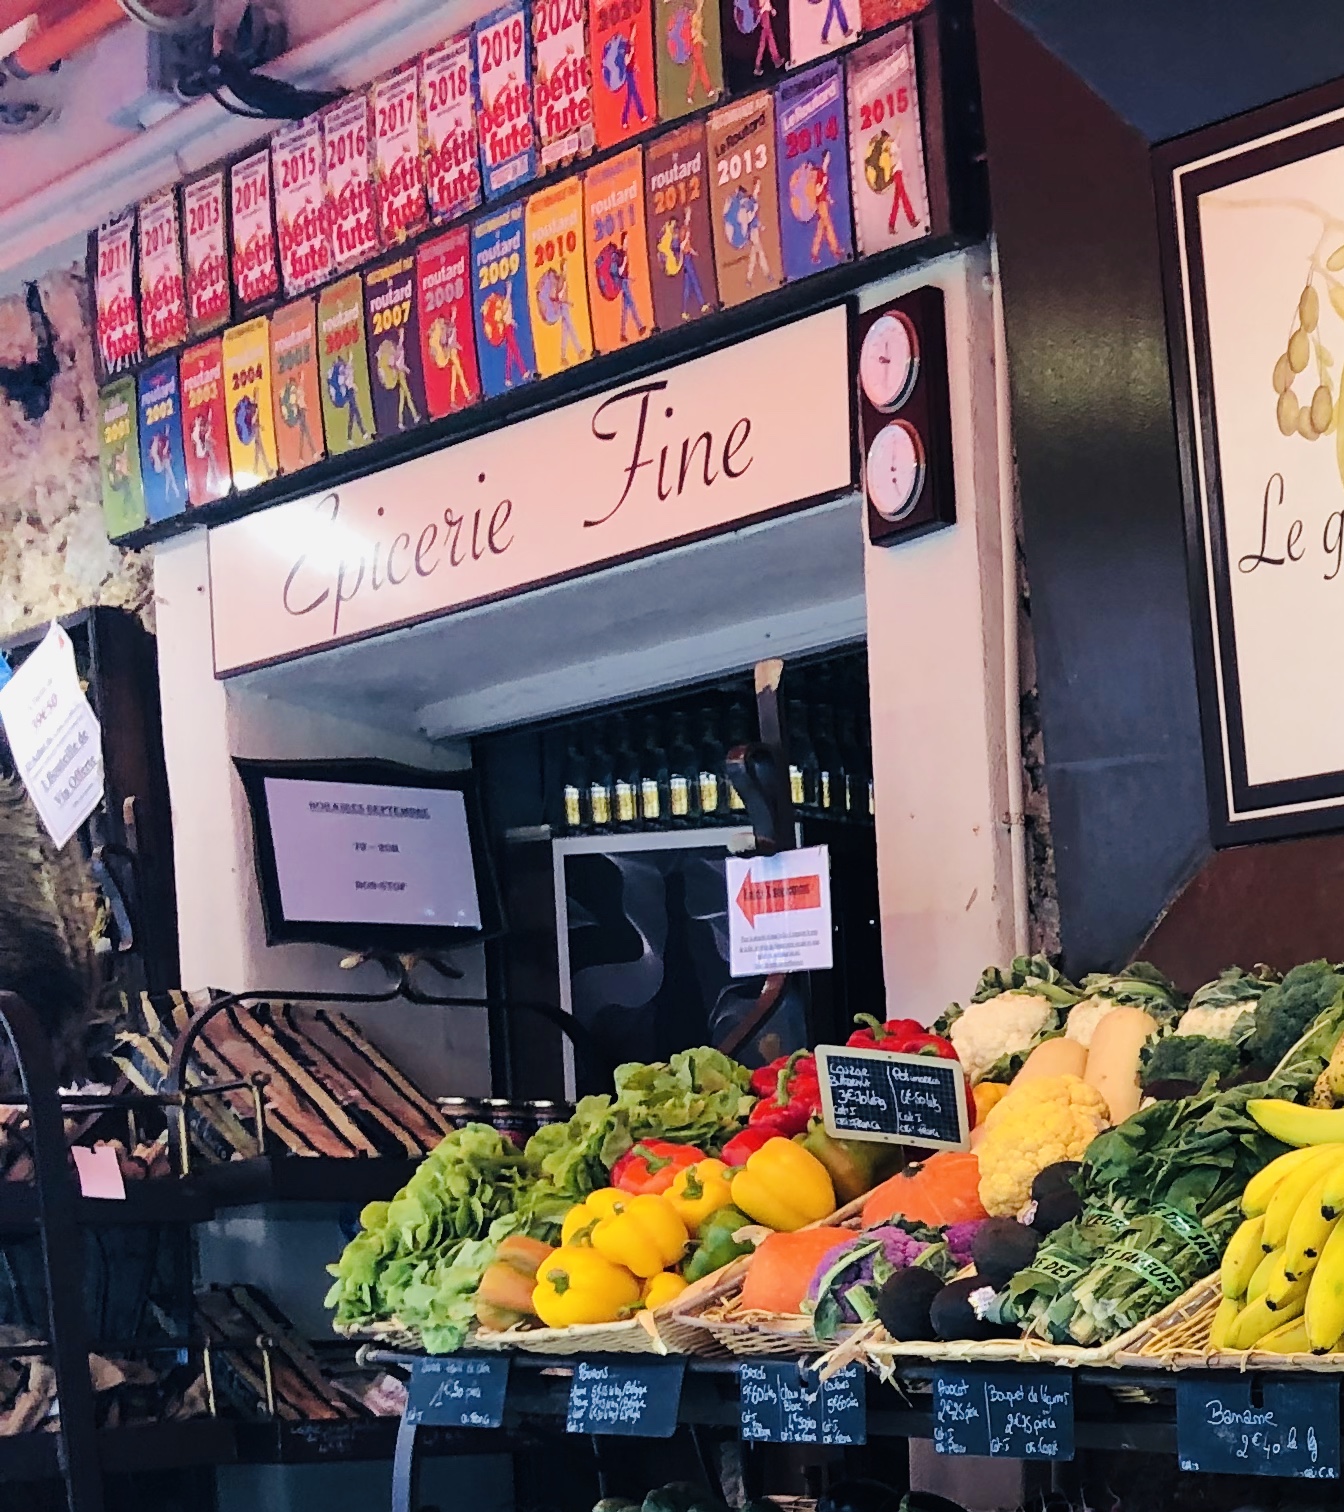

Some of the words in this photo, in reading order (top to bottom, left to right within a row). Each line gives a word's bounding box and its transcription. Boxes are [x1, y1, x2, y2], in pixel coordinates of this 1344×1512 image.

[481, 19, 522, 73] 2019
[429, 65, 466, 111] 2018
[378, 93, 414, 136] 2017
[860, 88, 908, 130] 2015
[328, 125, 364, 170] 2016
[785, 115, 838, 159] 2014
[281, 147, 316, 188] 2015
[652, 152, 700, 191] routard
[717, 144, 767, 185] 2013
[235, 180, 268, 214] 2014
[591, 180, 637, 217] routard
[654, 177, 700, 214] 2012
[189, 196, 220, 235] 2013
[145, 219, 173, 256] 2012
[477, 230, 520, 266] routard
[534, 231, 576, 268] 2010
[100, 240, 130, 277] 2011
[423, 257, 465, 290] routard
[479, 253, 520, 289] 2009
[371, 280, 412, 312] routard
[373, 301, 411, 335] 2007
[232, 363, 262, 390] 2004
[583, 379, 754, 529] Fine
[1238, 473, 1305, 573] Le
[1206, 1399, 1278, 1427] Banane
